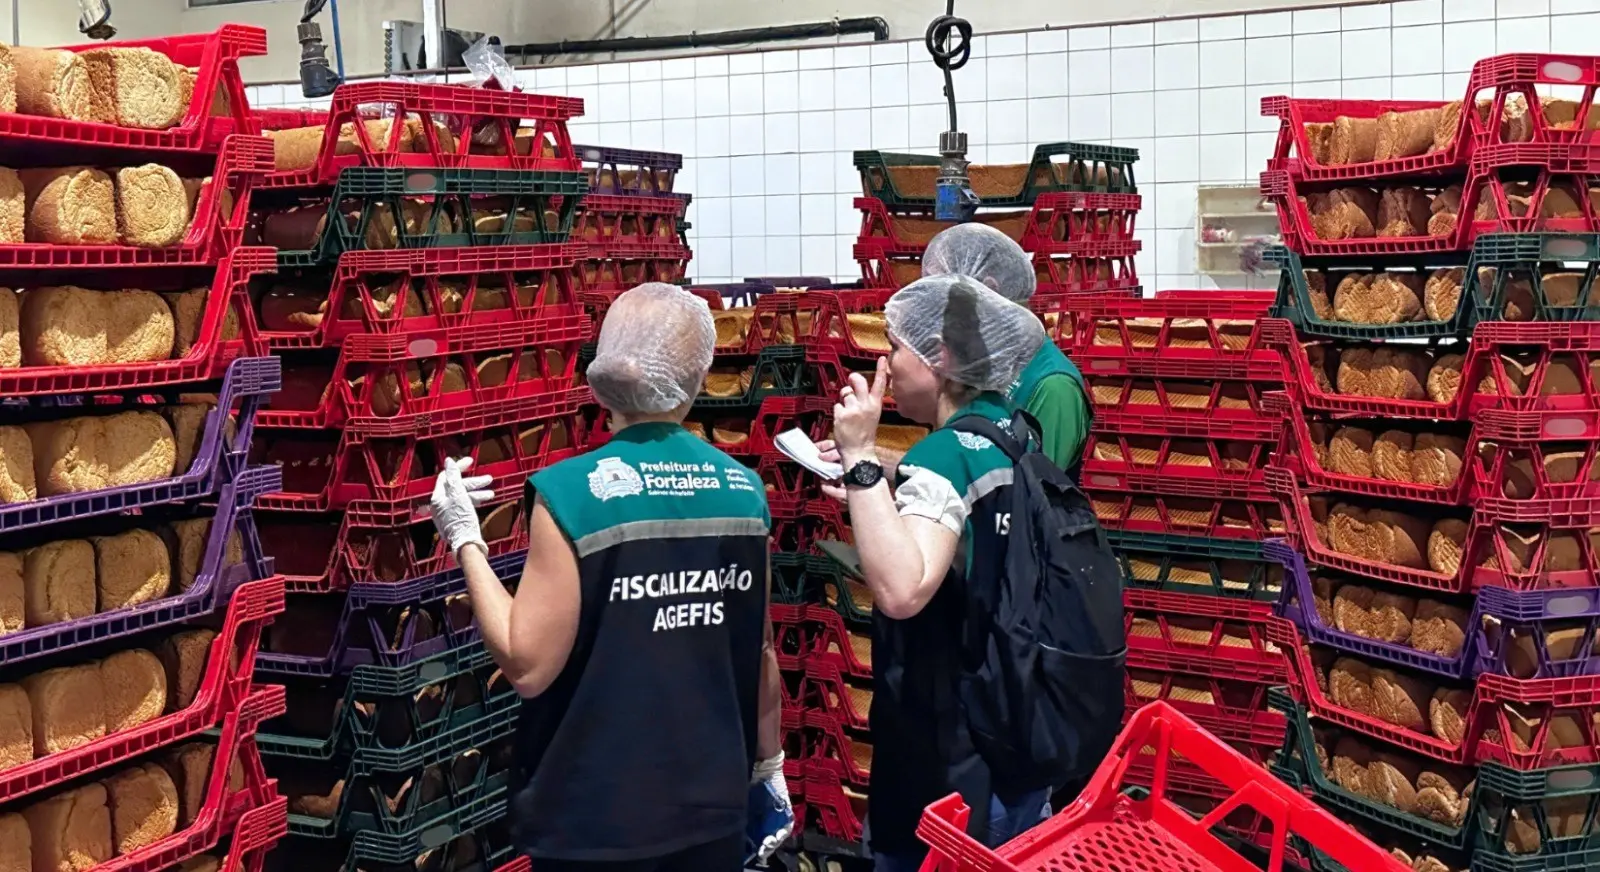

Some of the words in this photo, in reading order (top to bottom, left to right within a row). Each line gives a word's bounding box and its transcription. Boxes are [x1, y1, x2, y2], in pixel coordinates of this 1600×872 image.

[639, 462, 699, 473] Prefeitura
[702, 461, 716, 472] de
[643, 473, 720, 489] Fortaleza
[609, 563, 753, 601] FISCALIZAÇÃO
[652, 601, 724, 632] AGEFIS
